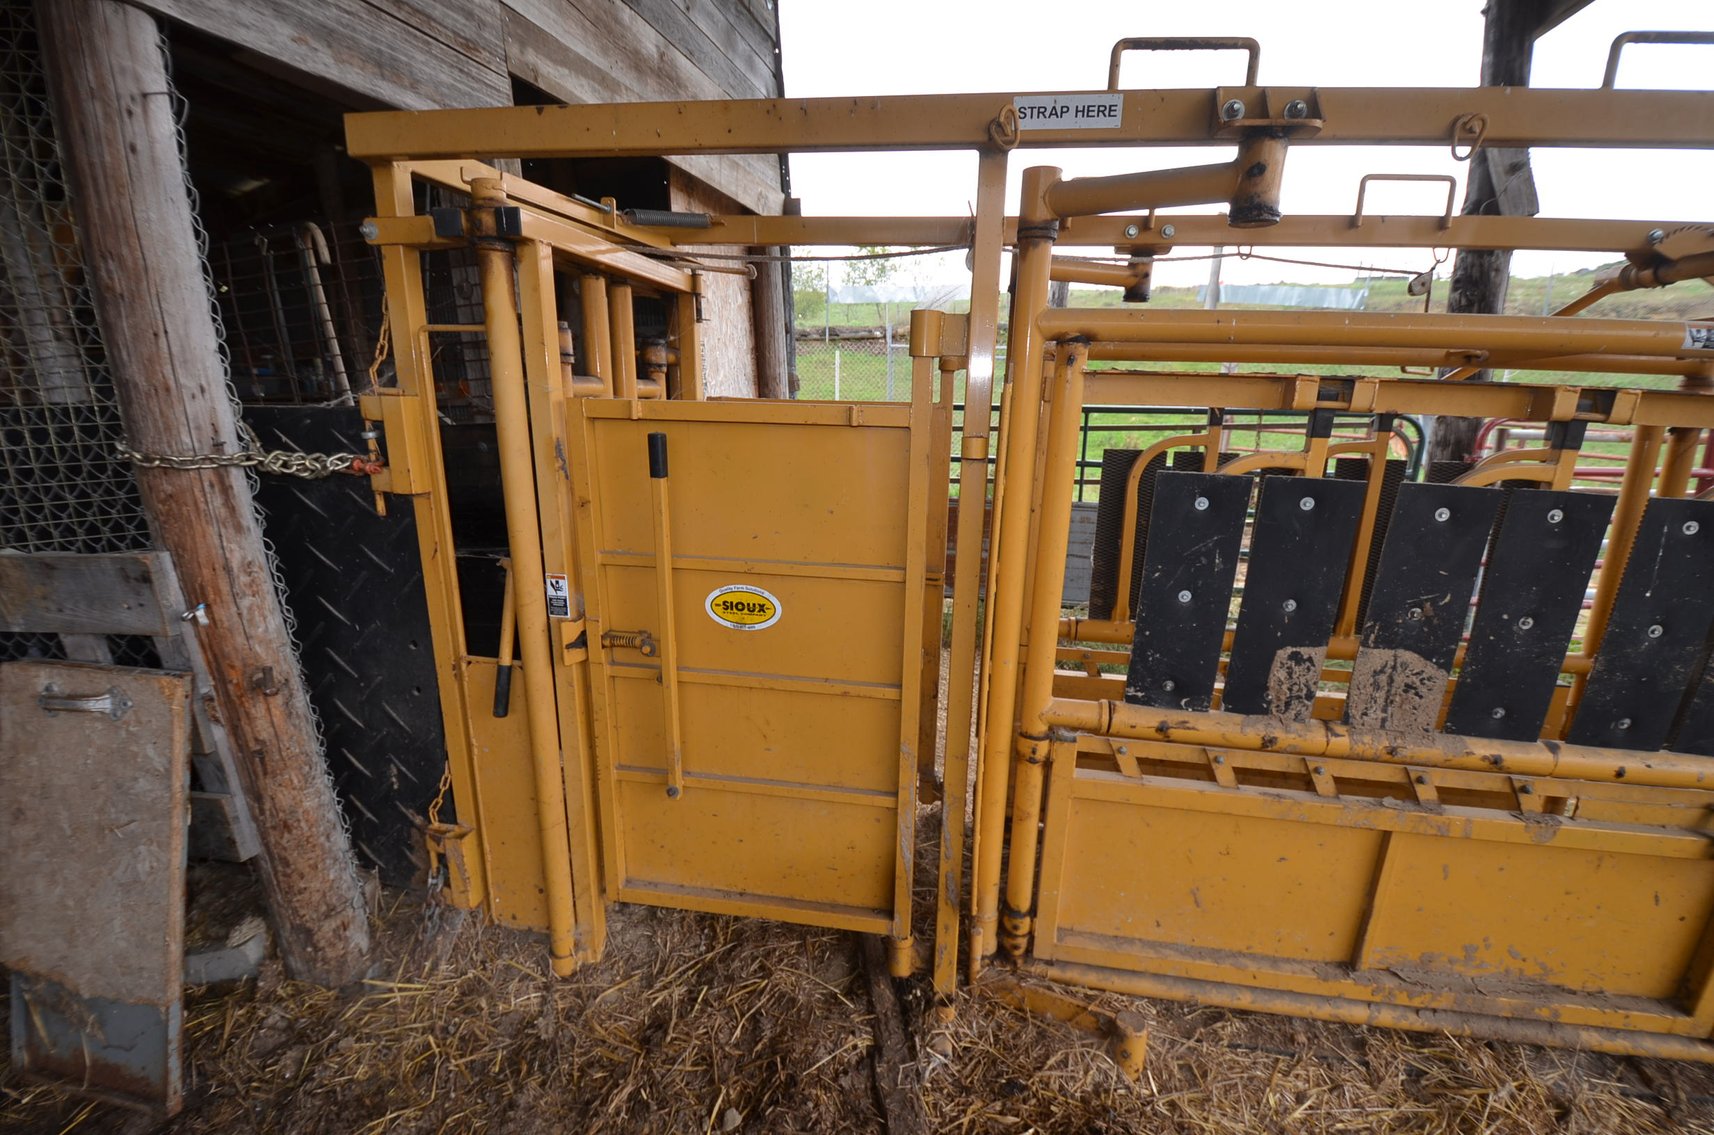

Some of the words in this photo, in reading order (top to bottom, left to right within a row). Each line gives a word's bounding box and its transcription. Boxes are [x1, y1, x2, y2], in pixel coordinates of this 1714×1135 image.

[1018, 105, 1070, 120] STRAP
[1074, 104, 1118, 119] HERE
[722, 600, 767, 614] SIOUX
